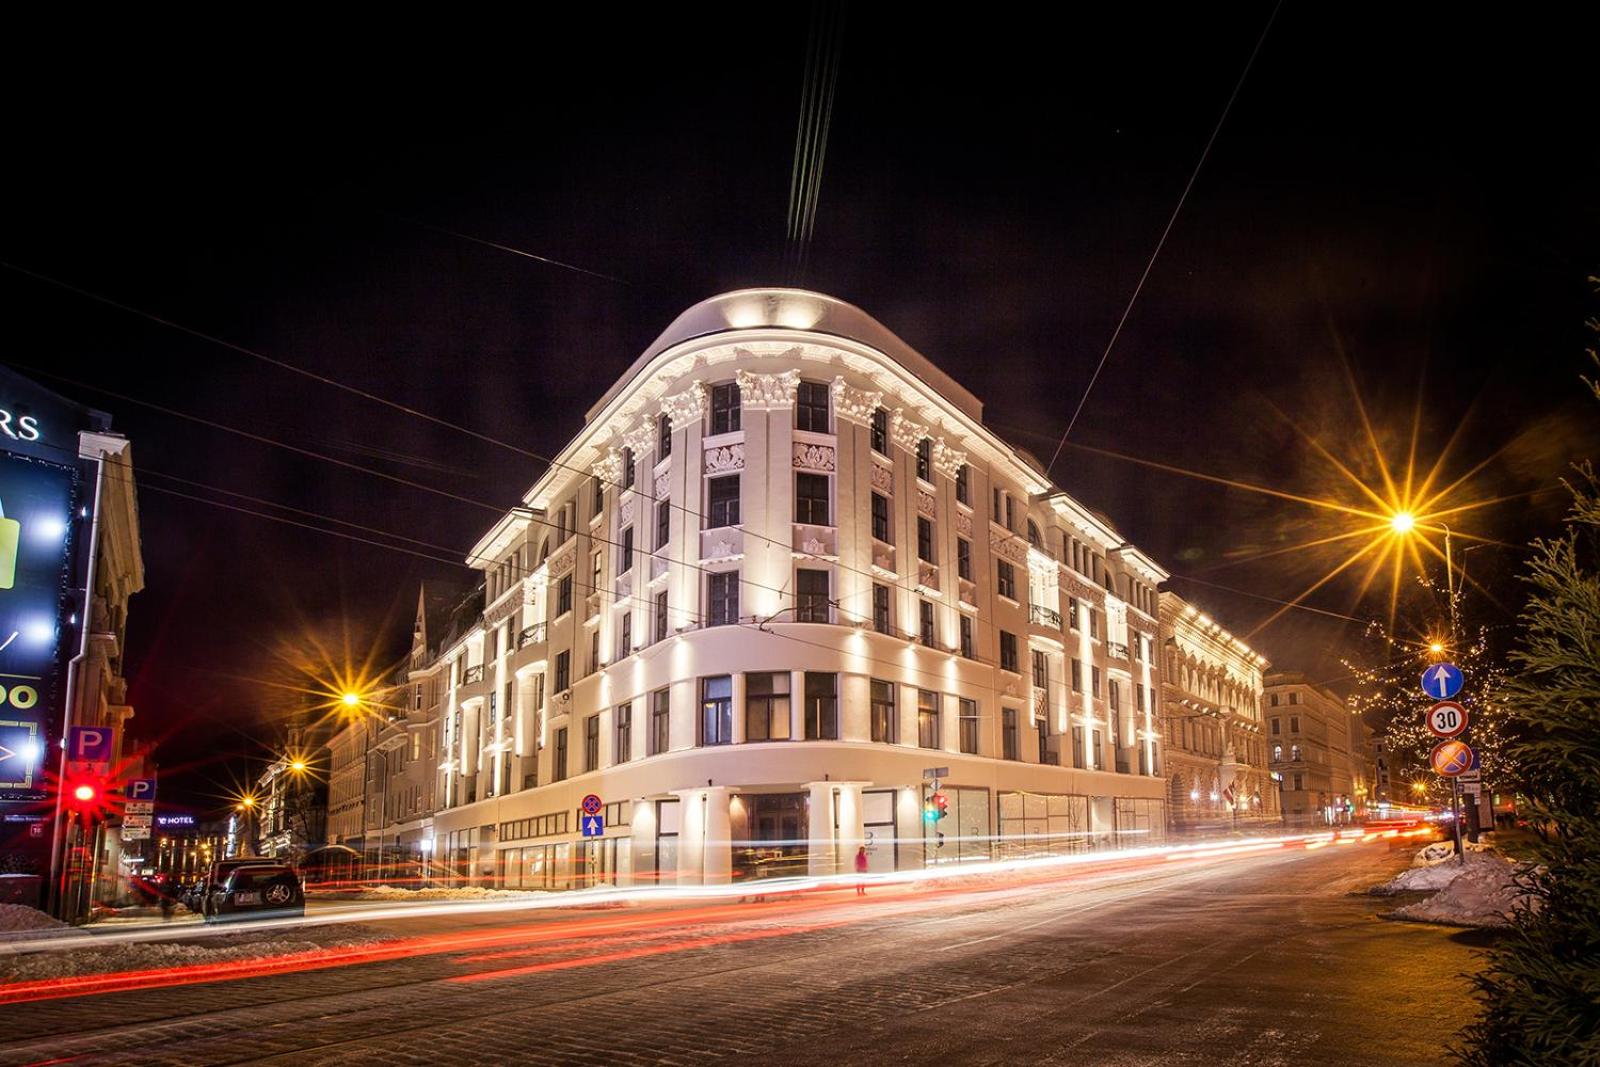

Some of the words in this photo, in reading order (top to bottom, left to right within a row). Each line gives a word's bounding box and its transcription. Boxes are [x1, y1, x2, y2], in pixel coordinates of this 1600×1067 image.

[1436, 711, 1457, 729] 30
[79, 730, 103, 755] P
[133, 781, 149, 798] P
[168, 816, 194, 825] HOTEL
